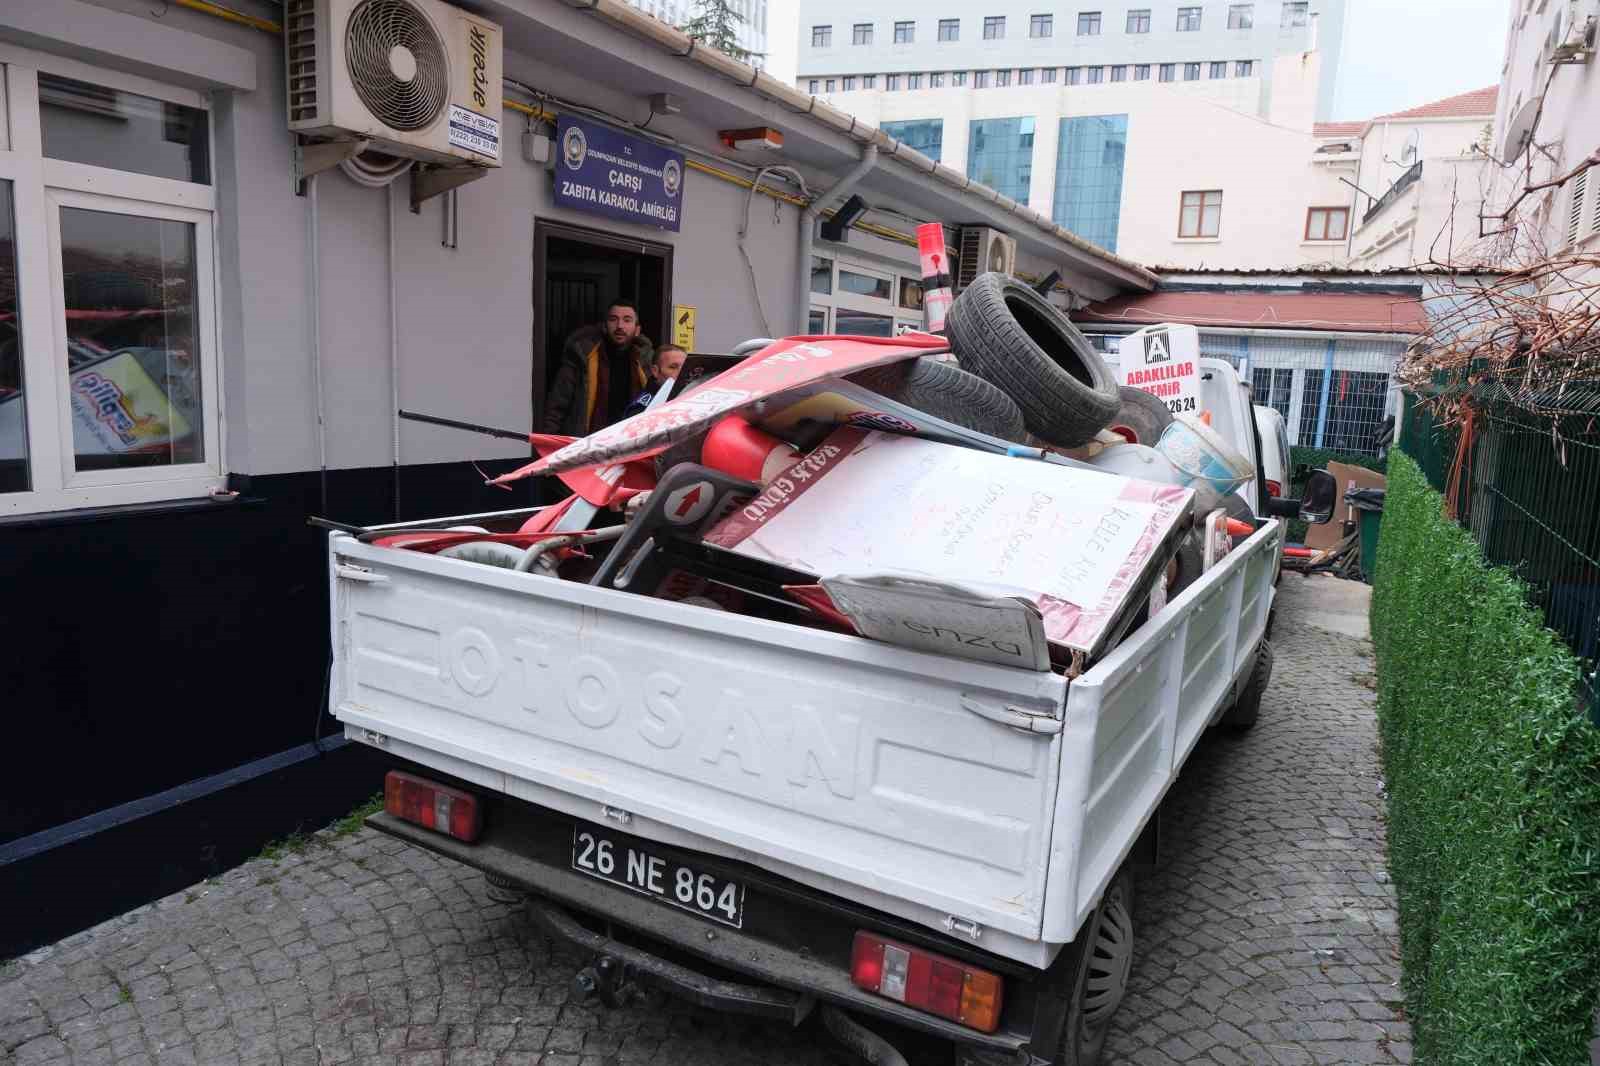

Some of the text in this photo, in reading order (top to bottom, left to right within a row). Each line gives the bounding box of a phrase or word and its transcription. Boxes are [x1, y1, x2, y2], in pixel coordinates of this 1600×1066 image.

[470, 26, 486, 108] arçelik
[562, 181, 677, 222] ZABITA KARAKOL AMİRLİĞİ
[609, 169, 642, 192] ÇARŞI
[1127, 362, 1193, 385] ABAKLILAR
[1170, 397, 1196, 413] 26 24
[743, 445, 840, 522] HALK GÜNÜ
[449, 625, 860, 801] OTOSAN
[577, 832, 737, 920] 26 NE 864
